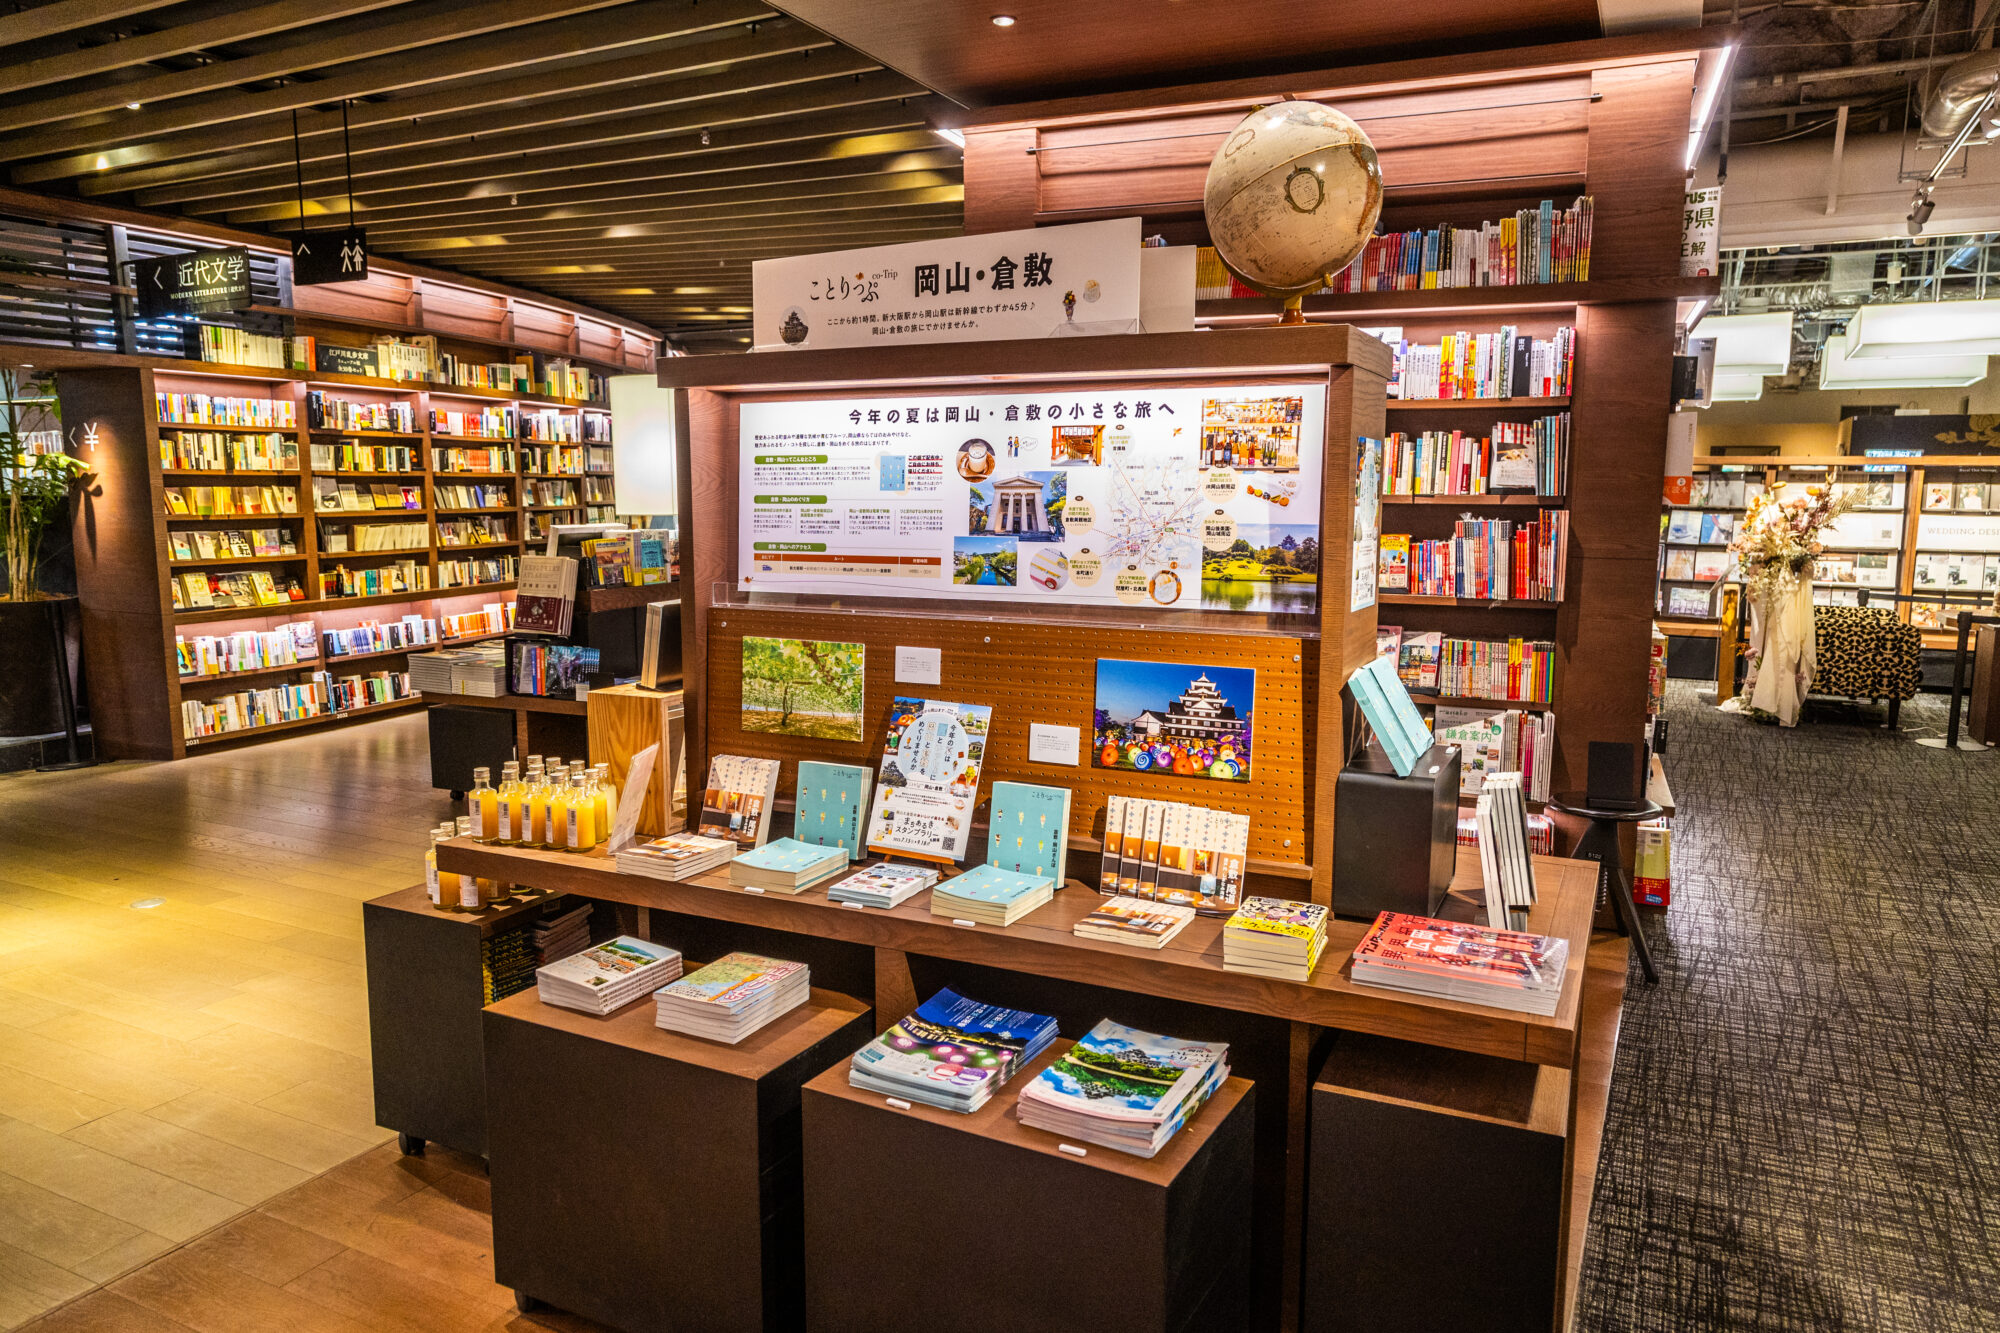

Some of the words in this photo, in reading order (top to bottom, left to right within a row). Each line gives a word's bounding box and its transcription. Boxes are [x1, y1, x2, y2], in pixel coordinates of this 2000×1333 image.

[178, 255, 245, 287] 近代文学
[871, 269, 899, 281] co-Trip
[914, 251, 1054, 298] 岡山・倉敷
[170, 291, 193, 299] MODERN
[194, 287, 228, 297] LITERATURE
[809, 275, 880, 303] ことりっぷ
[871, 321, 980, 336] 岡山・倉敷の旅にでかけませんか。
[329, 349, 369, 360] 江戸川乱歩文庫
[849, 401, 1175, 425] 今年の夏は岡山・倉敷の小さな旅へ
[1927, 527, 1977, 536] WEDDING
[1445, 728, 1493, 743] 鎌倉案内
[909, 720, 925, 771] めぐりませんか
[903, 817, 934, 829] まちあるき
[895, 826, 939, 839] スタンプラリー
[1050, 841, 1058, 868] 岡山さんぽ
